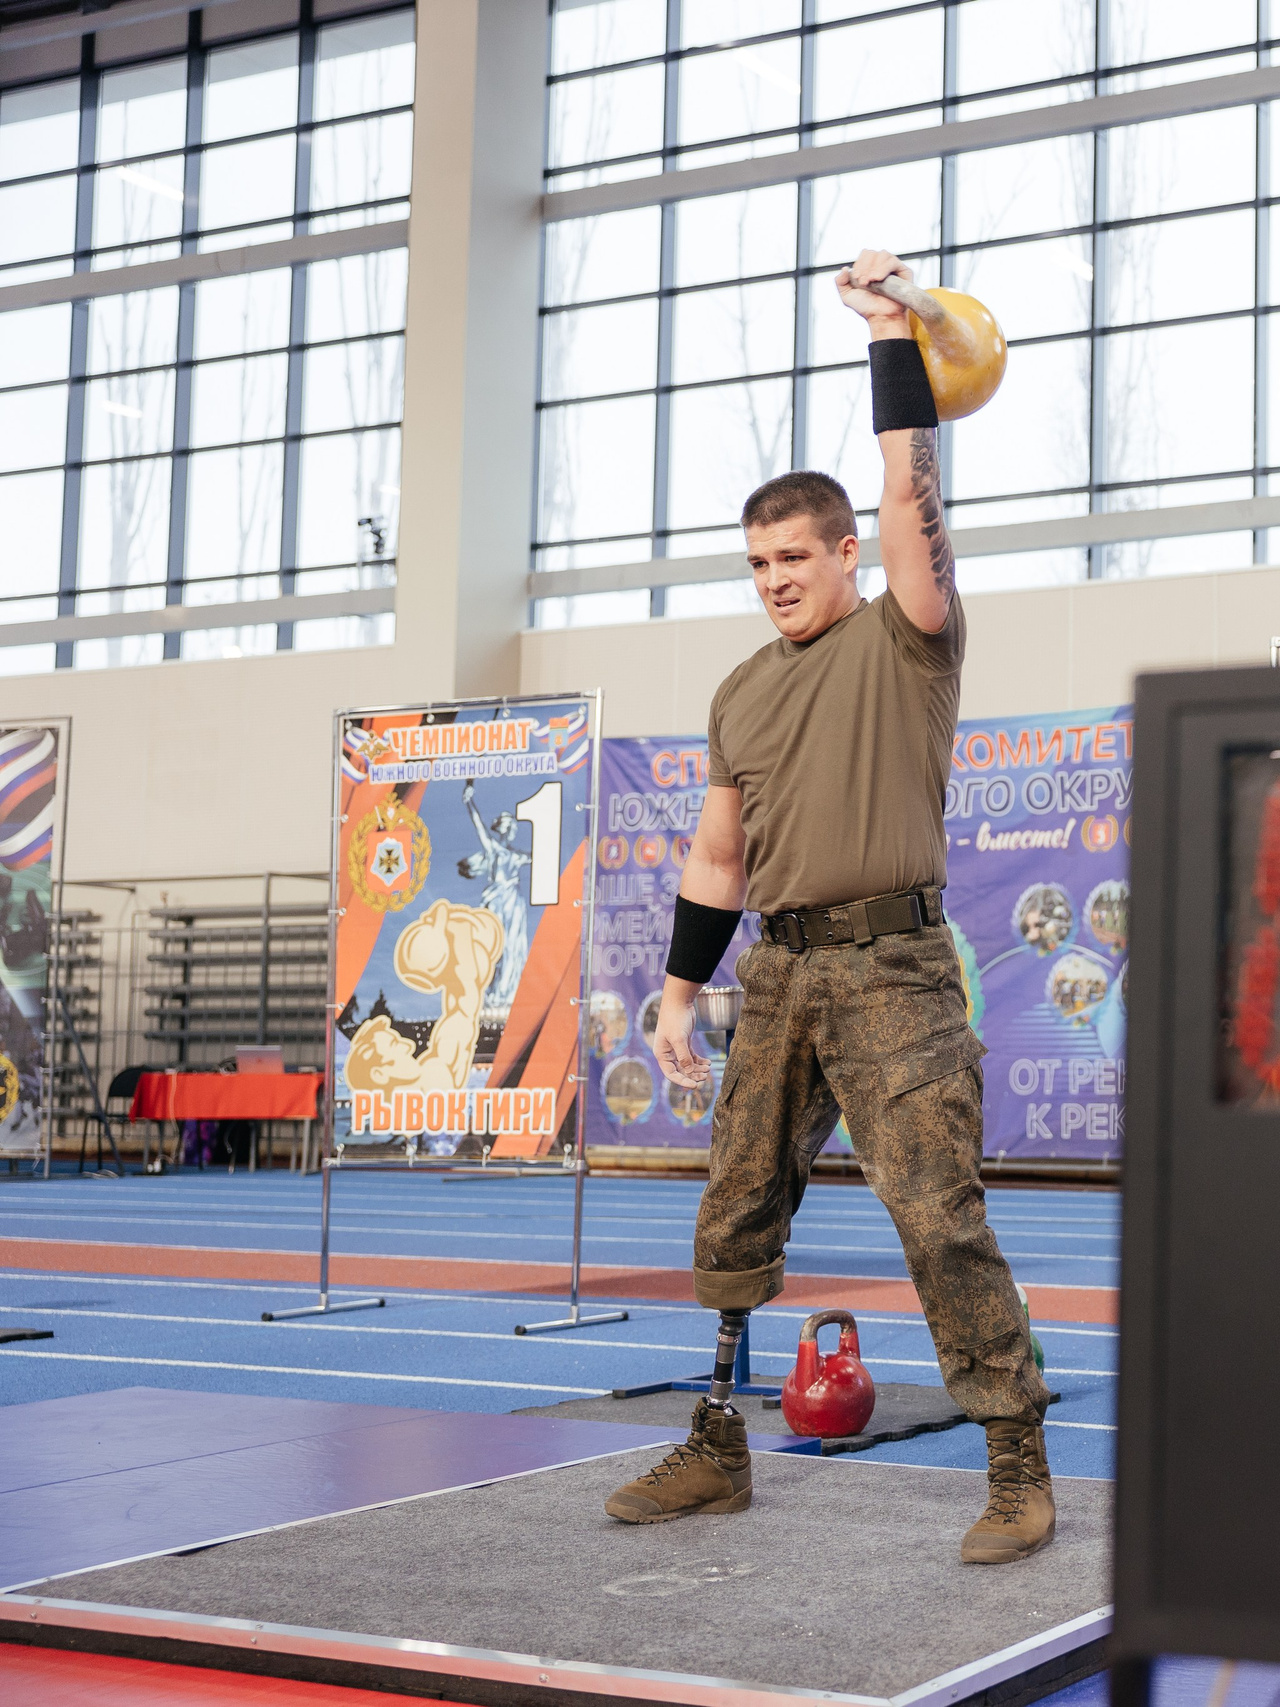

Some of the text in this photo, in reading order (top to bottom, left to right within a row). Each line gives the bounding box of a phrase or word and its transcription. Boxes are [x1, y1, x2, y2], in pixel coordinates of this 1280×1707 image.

[391, 720, 532, 758] ЧЕМПИОНАТ
[370, 754, 556, 783] ЮЖНОГО ВОЕННОГО ОКРУГА
[515, 781, 562, 906] 1
[1009, 1058, 1062, 1095] ОТ
[353, 1089, 554, 1132] РЫВОК ГИРИ
[1026, 1102, 1053, 1140] К
